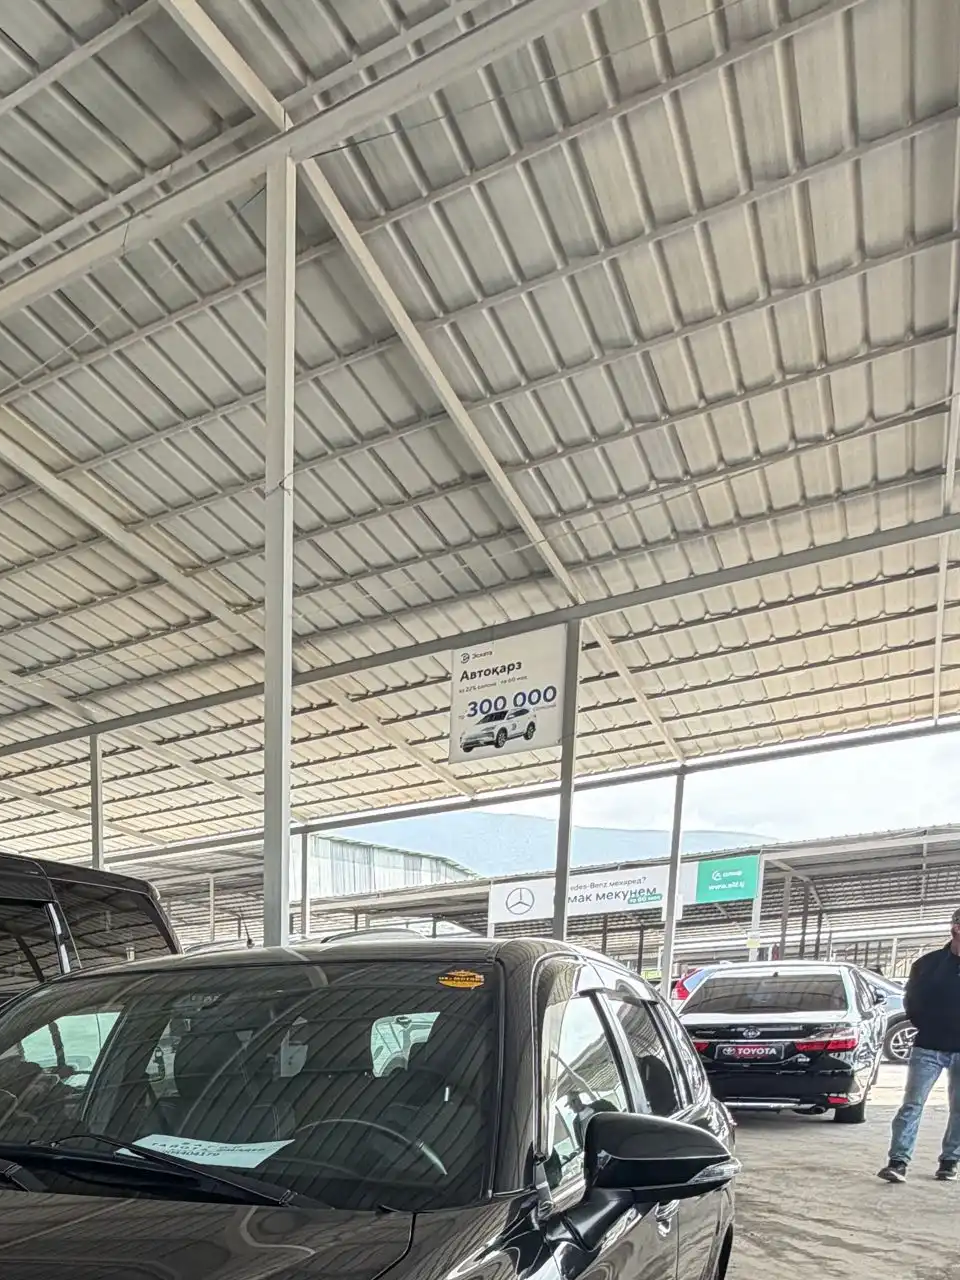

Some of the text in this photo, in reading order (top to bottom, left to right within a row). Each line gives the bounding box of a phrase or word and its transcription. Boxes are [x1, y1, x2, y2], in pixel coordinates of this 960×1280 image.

[460, 661, 523, 681] Автоқарз
[467, 695, 507, 718] 300
[512, 685, 557, 707] 000
[737, 1047, 777, 1056] TOYOTA
